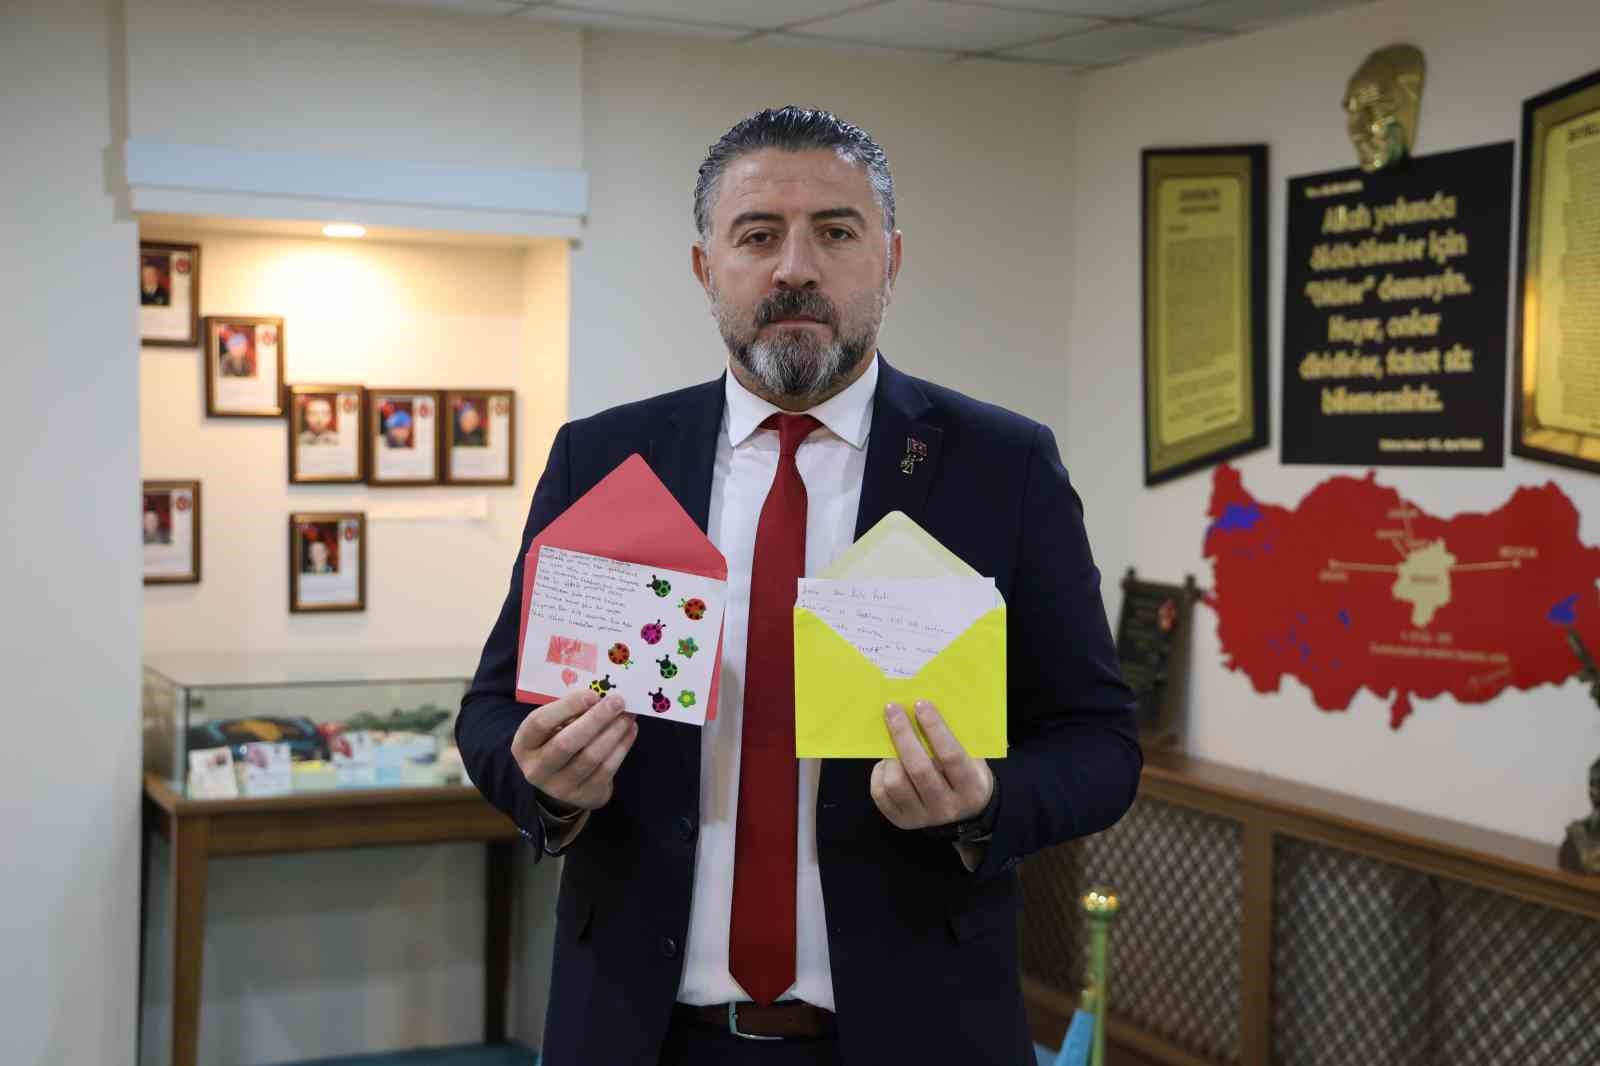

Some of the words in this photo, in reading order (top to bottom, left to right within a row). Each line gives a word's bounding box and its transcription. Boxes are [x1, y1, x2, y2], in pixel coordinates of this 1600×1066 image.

[1321, 202, 1372, 233] Allah
[1374, 191, 1457, 233] yolunda
[1428, 228, 1468, 263] için
[1377, 268, 1472, 303] demeyin.
[1386, 307, 1441, 337] onlar
